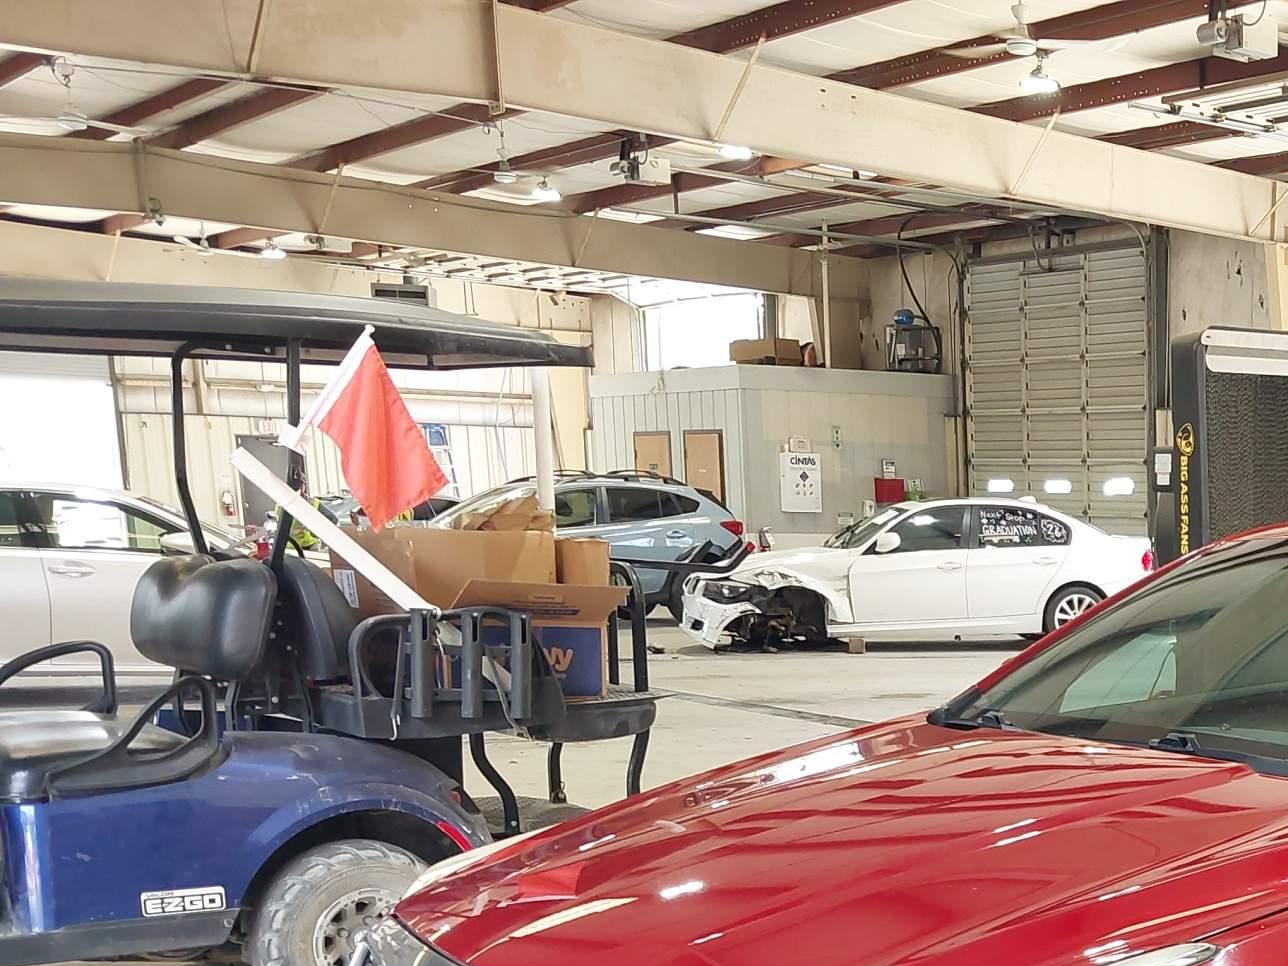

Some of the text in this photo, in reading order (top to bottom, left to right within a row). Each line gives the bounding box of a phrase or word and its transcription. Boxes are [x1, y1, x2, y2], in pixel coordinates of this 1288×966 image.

[1180, 455, 1189, 555] BIG ASS FANS
[980, 510, 1002, 519] Next
[982, 525, 1037, 536] GRADUATION
[1047, 524, 1061, 538] 26
